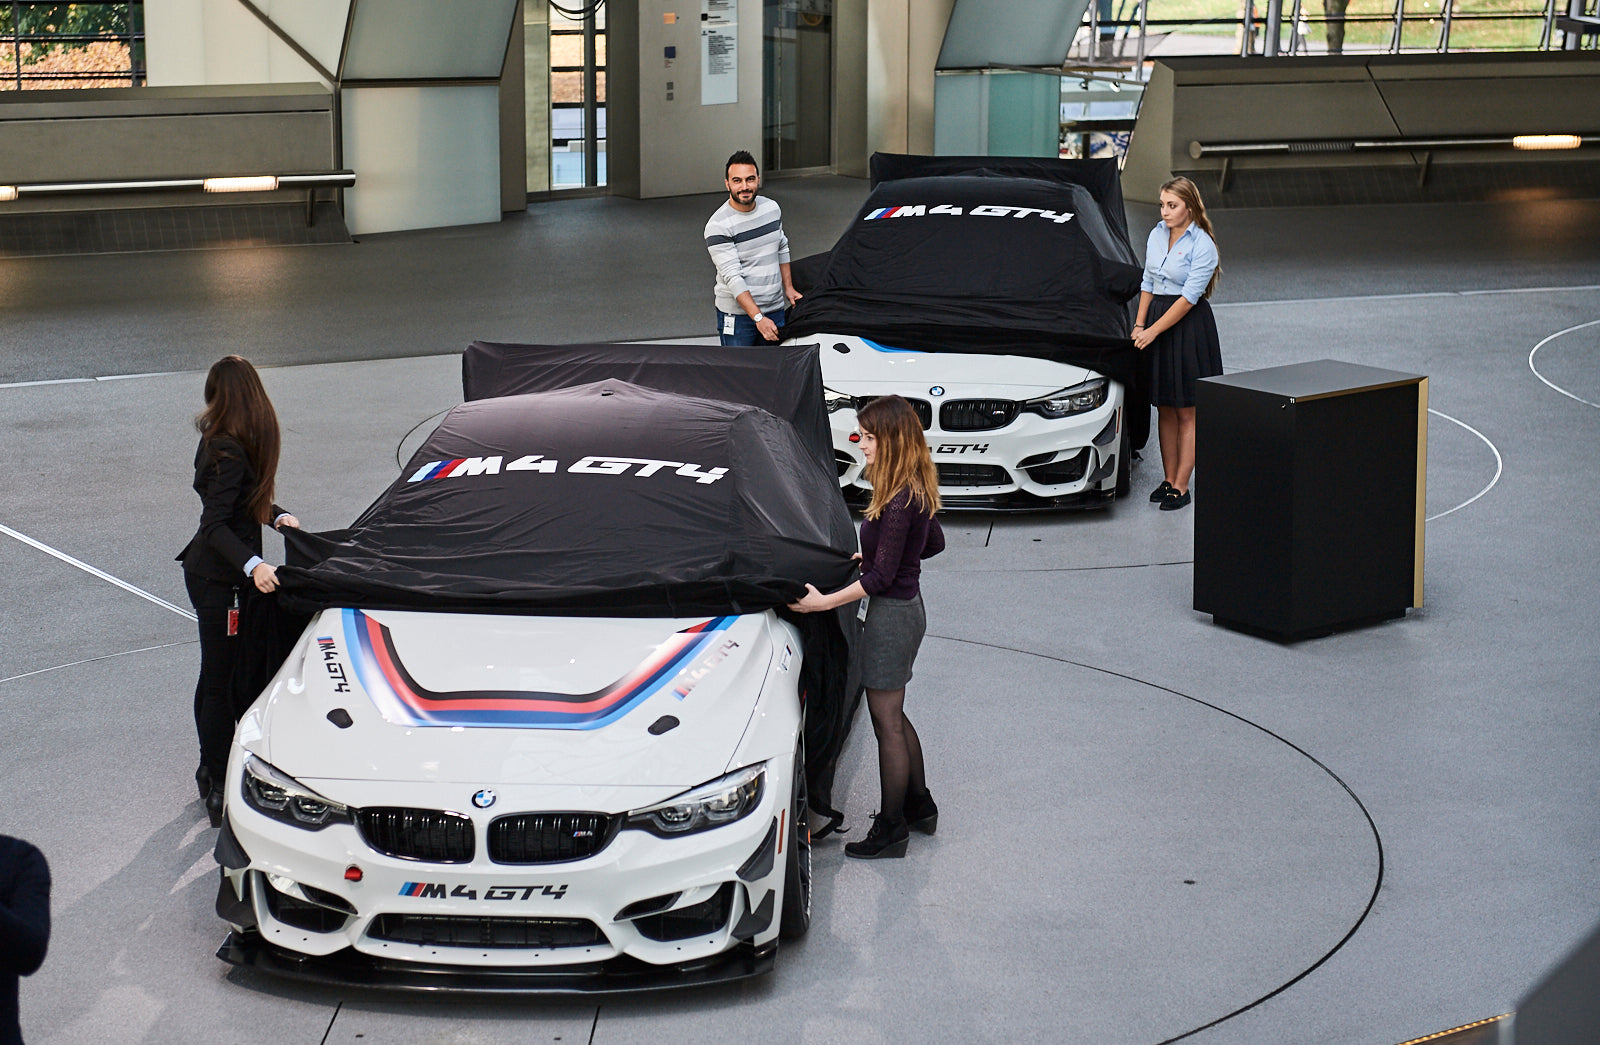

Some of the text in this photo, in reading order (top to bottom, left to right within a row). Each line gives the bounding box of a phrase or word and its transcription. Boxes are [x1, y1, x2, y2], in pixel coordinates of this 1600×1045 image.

[968, 204, 1075, 224] GT4
[936, 443, 990, 454] GT4
[567, 456, 730, 484] GT4
[326, 662, 351, 693] GT4
[483, 884, 569, 901] GT4
